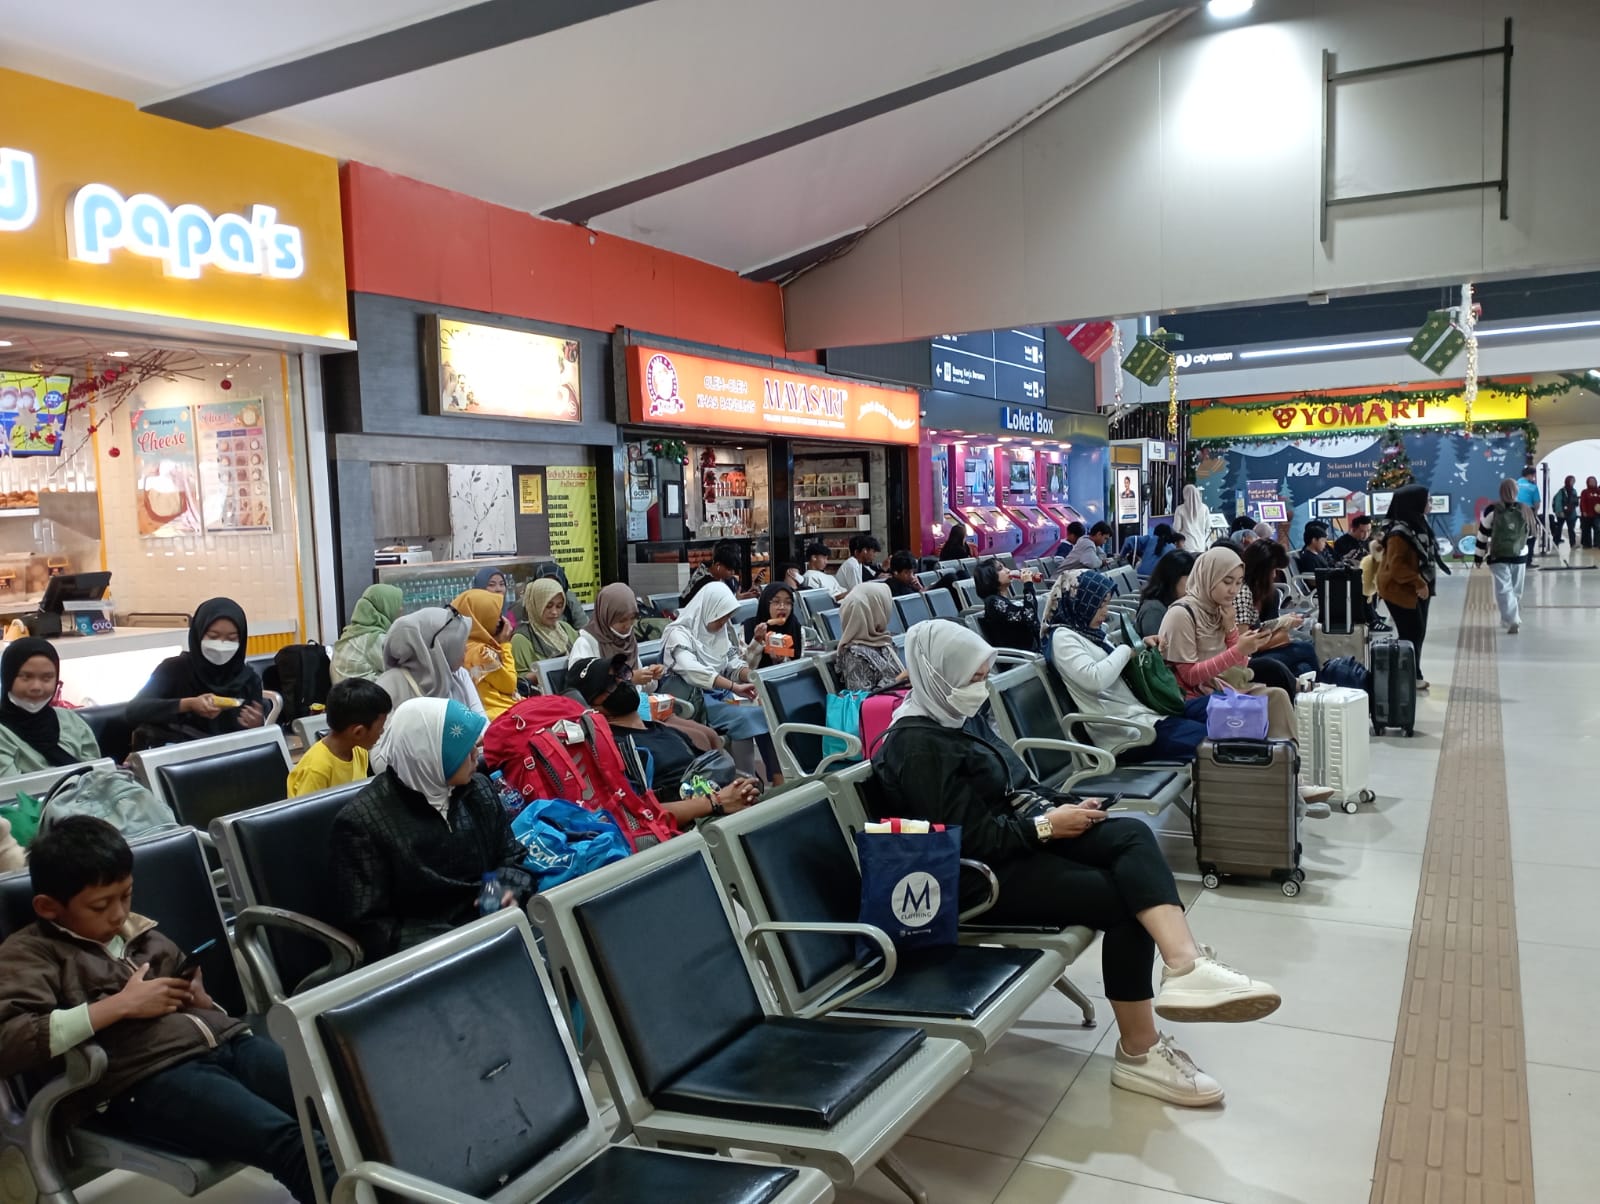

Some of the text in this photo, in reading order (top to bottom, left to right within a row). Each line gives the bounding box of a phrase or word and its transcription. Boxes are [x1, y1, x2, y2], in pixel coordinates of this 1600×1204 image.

[75, 184, 303, 278] papa's
[1006, 406, 1054, 435] Loket Box
[137, 431, 185, 453] Cheese
[1286, 461, 1320, 477] KAI
[91, 621, 112, 631] OVO
[901, 879, 931, 913] M
